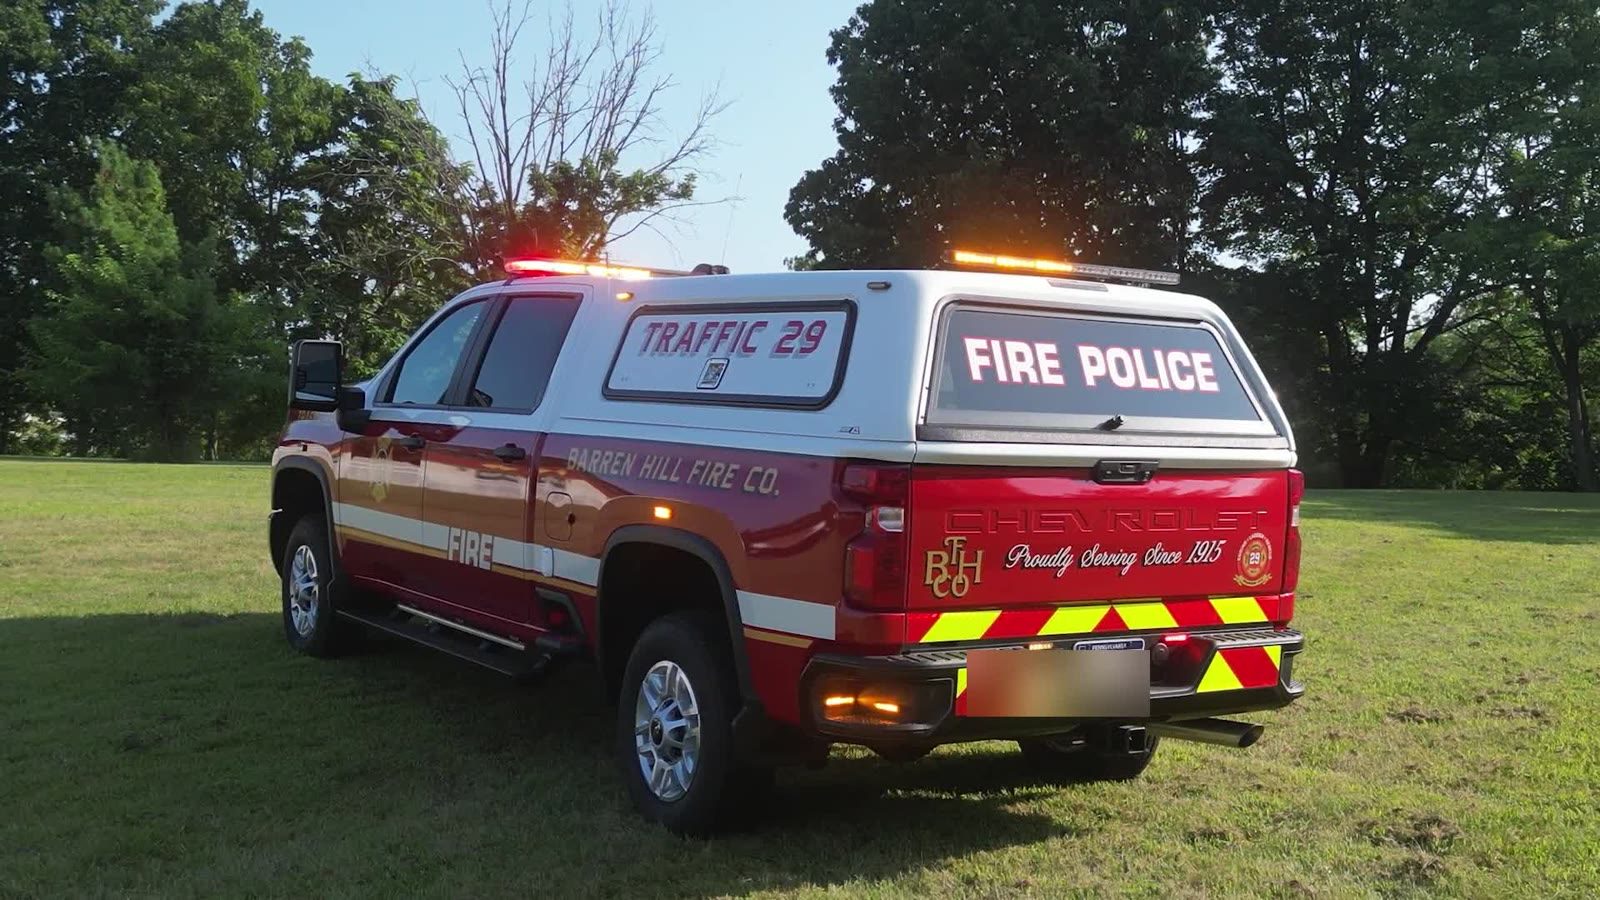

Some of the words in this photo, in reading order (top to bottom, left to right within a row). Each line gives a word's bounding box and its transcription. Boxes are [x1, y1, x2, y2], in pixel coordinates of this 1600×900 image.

[638, 320, 768, 356] TRAFFIC
[773, 319, 828, 357] 29
[962, 335, 1066, 386] FIRE
[1076, 342, 1221, 393] POLICE
[567, 447, 637, 477] BARREN
[639, 455, 683, 483] HILL
[687, 459, 740, 489] FIRE
[743, 466, 780, 496] CO.
[944, 507, 1268, 534] CHEVROLET
[447, 526, 494, 572] FIRE
[1005, 543, 1073, 578] Proudly
[1080, 543, 1137, 576] Serving
[1143, 541, 1182, 566] Since
[1185, 539, 1227, 564] 1915
[1249, 552, 1260, 565] 29
